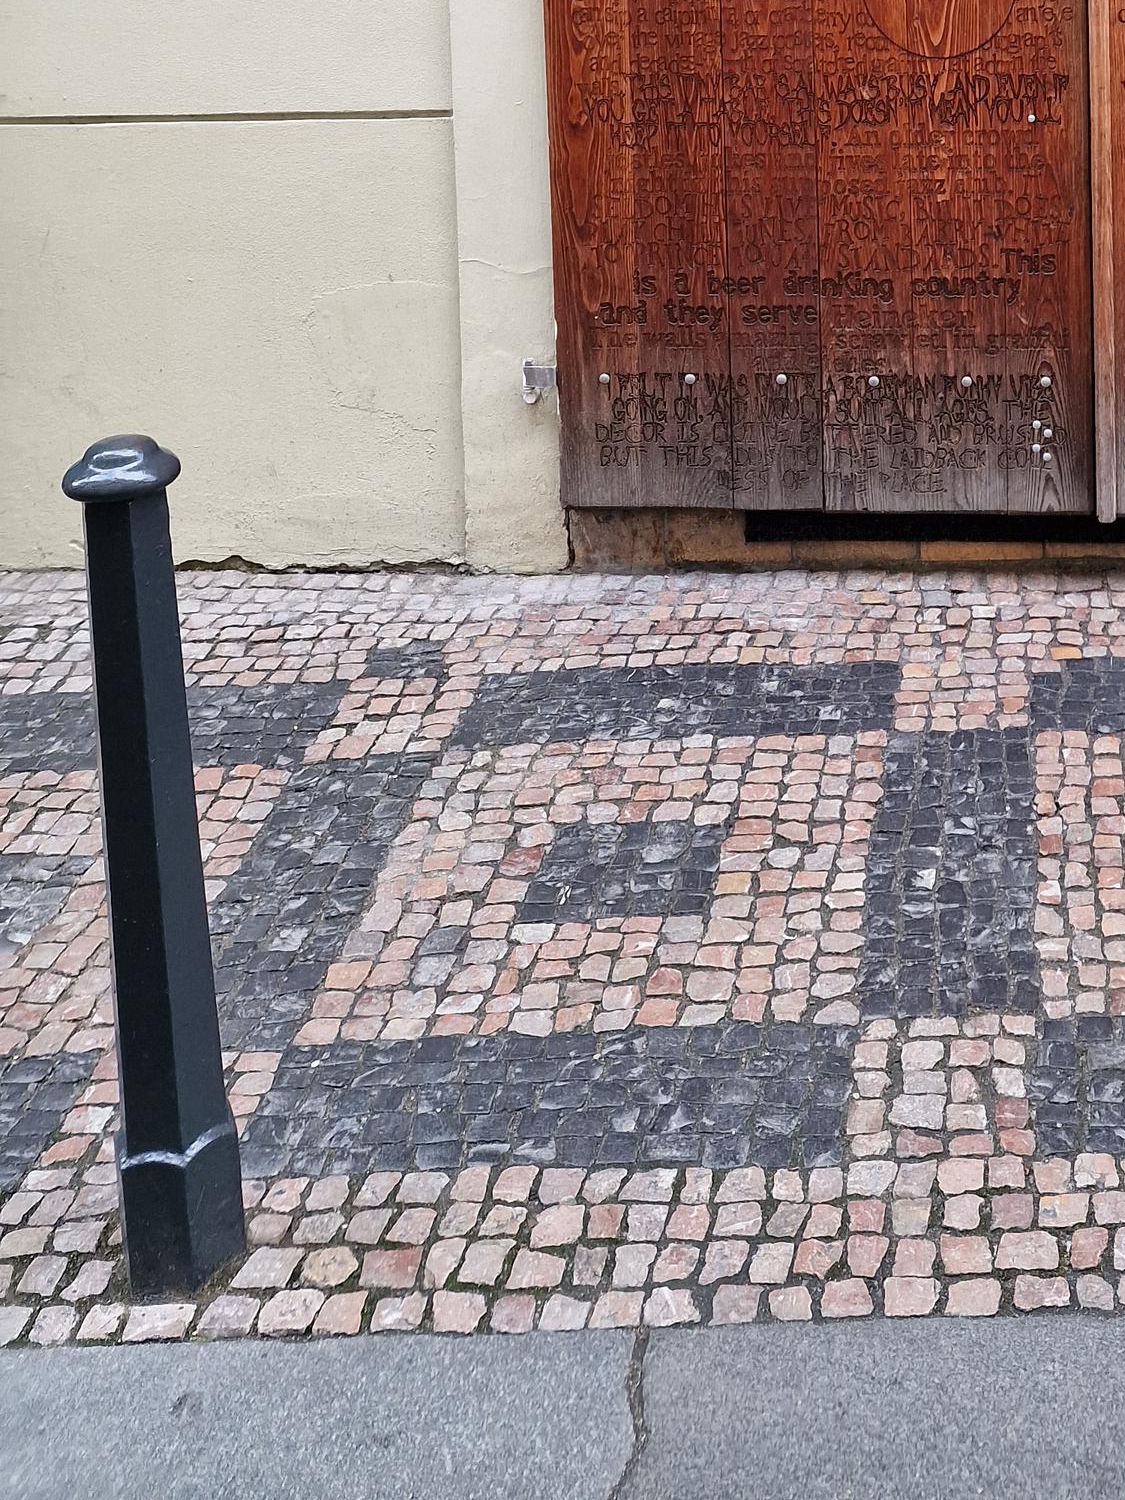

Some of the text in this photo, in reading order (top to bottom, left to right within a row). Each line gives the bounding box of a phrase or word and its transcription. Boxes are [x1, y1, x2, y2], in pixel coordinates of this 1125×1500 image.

[1000, 247, 1057, 276] This
[633, 268, 658, 297] is
[674, 271, 692, 297] a
[707, 269, 767, 297] beer
[598, 299, 648, 326] and
[663, 298, 725, 332] they
